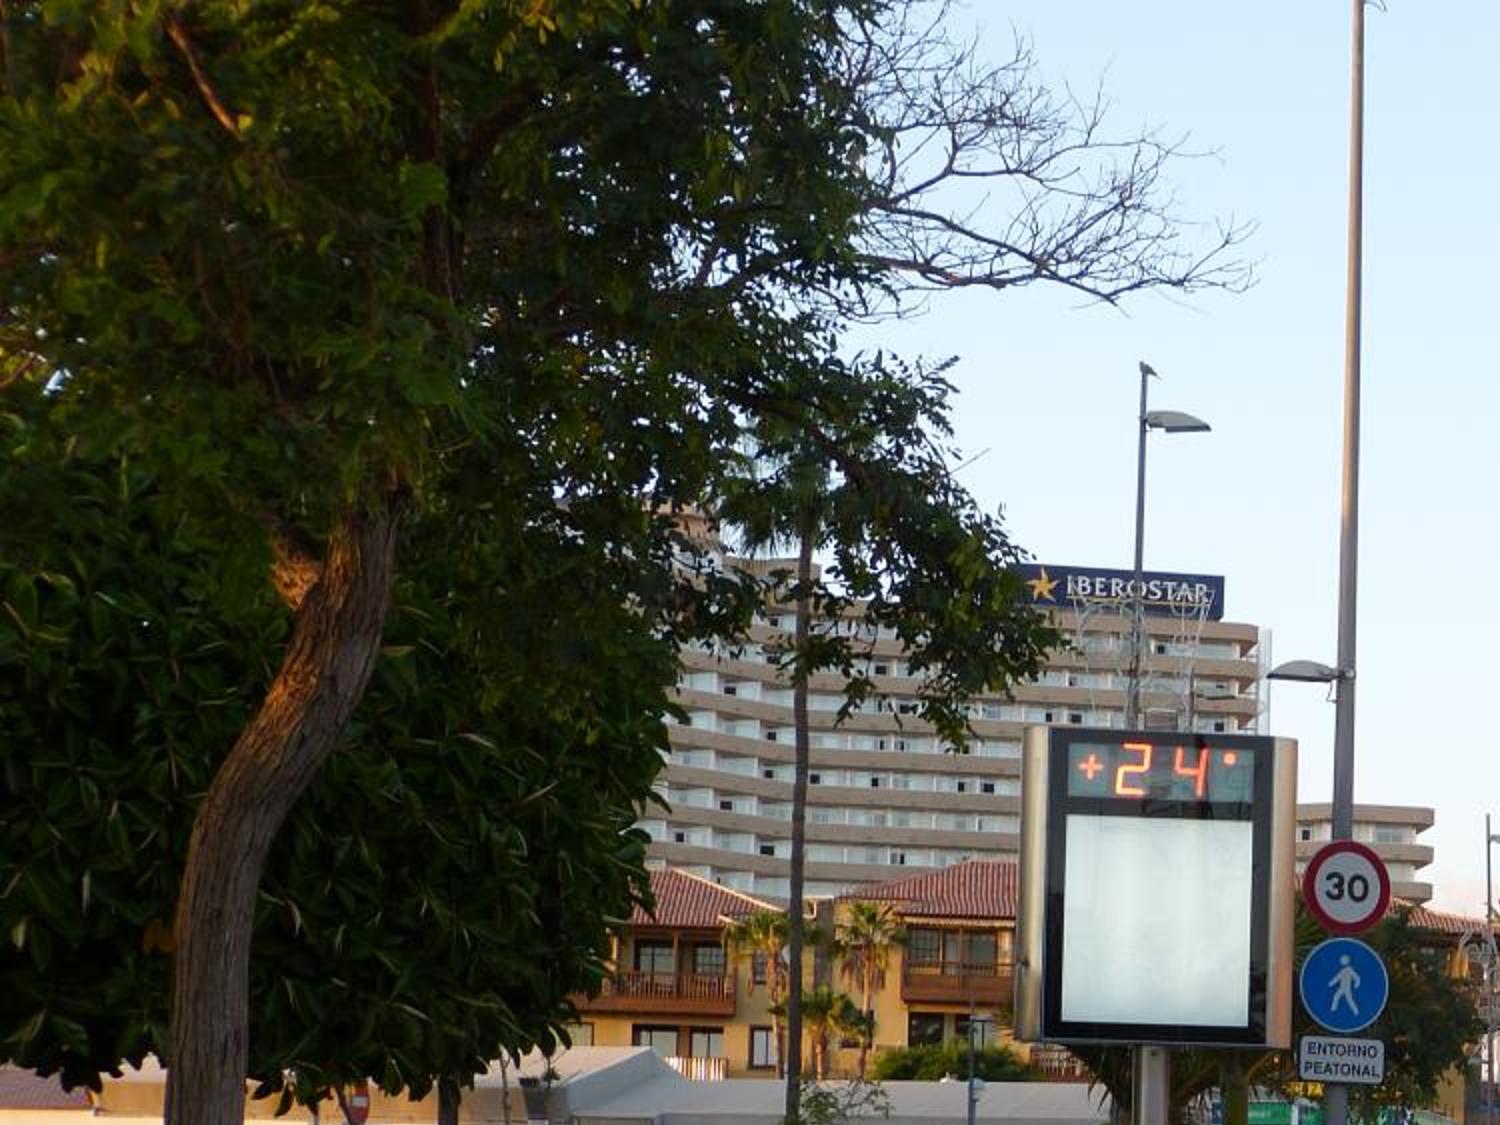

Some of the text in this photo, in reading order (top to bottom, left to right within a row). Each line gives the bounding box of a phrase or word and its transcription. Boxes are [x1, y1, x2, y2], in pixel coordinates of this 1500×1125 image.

[1066, 575, 1210, 605] IBEROSTAR
[1325, 872, 1370, 903] 30
[1307, 1041, 1378, 1058] ENTORNO
[1303, 1061, 1380, 1079] PEATONAL
